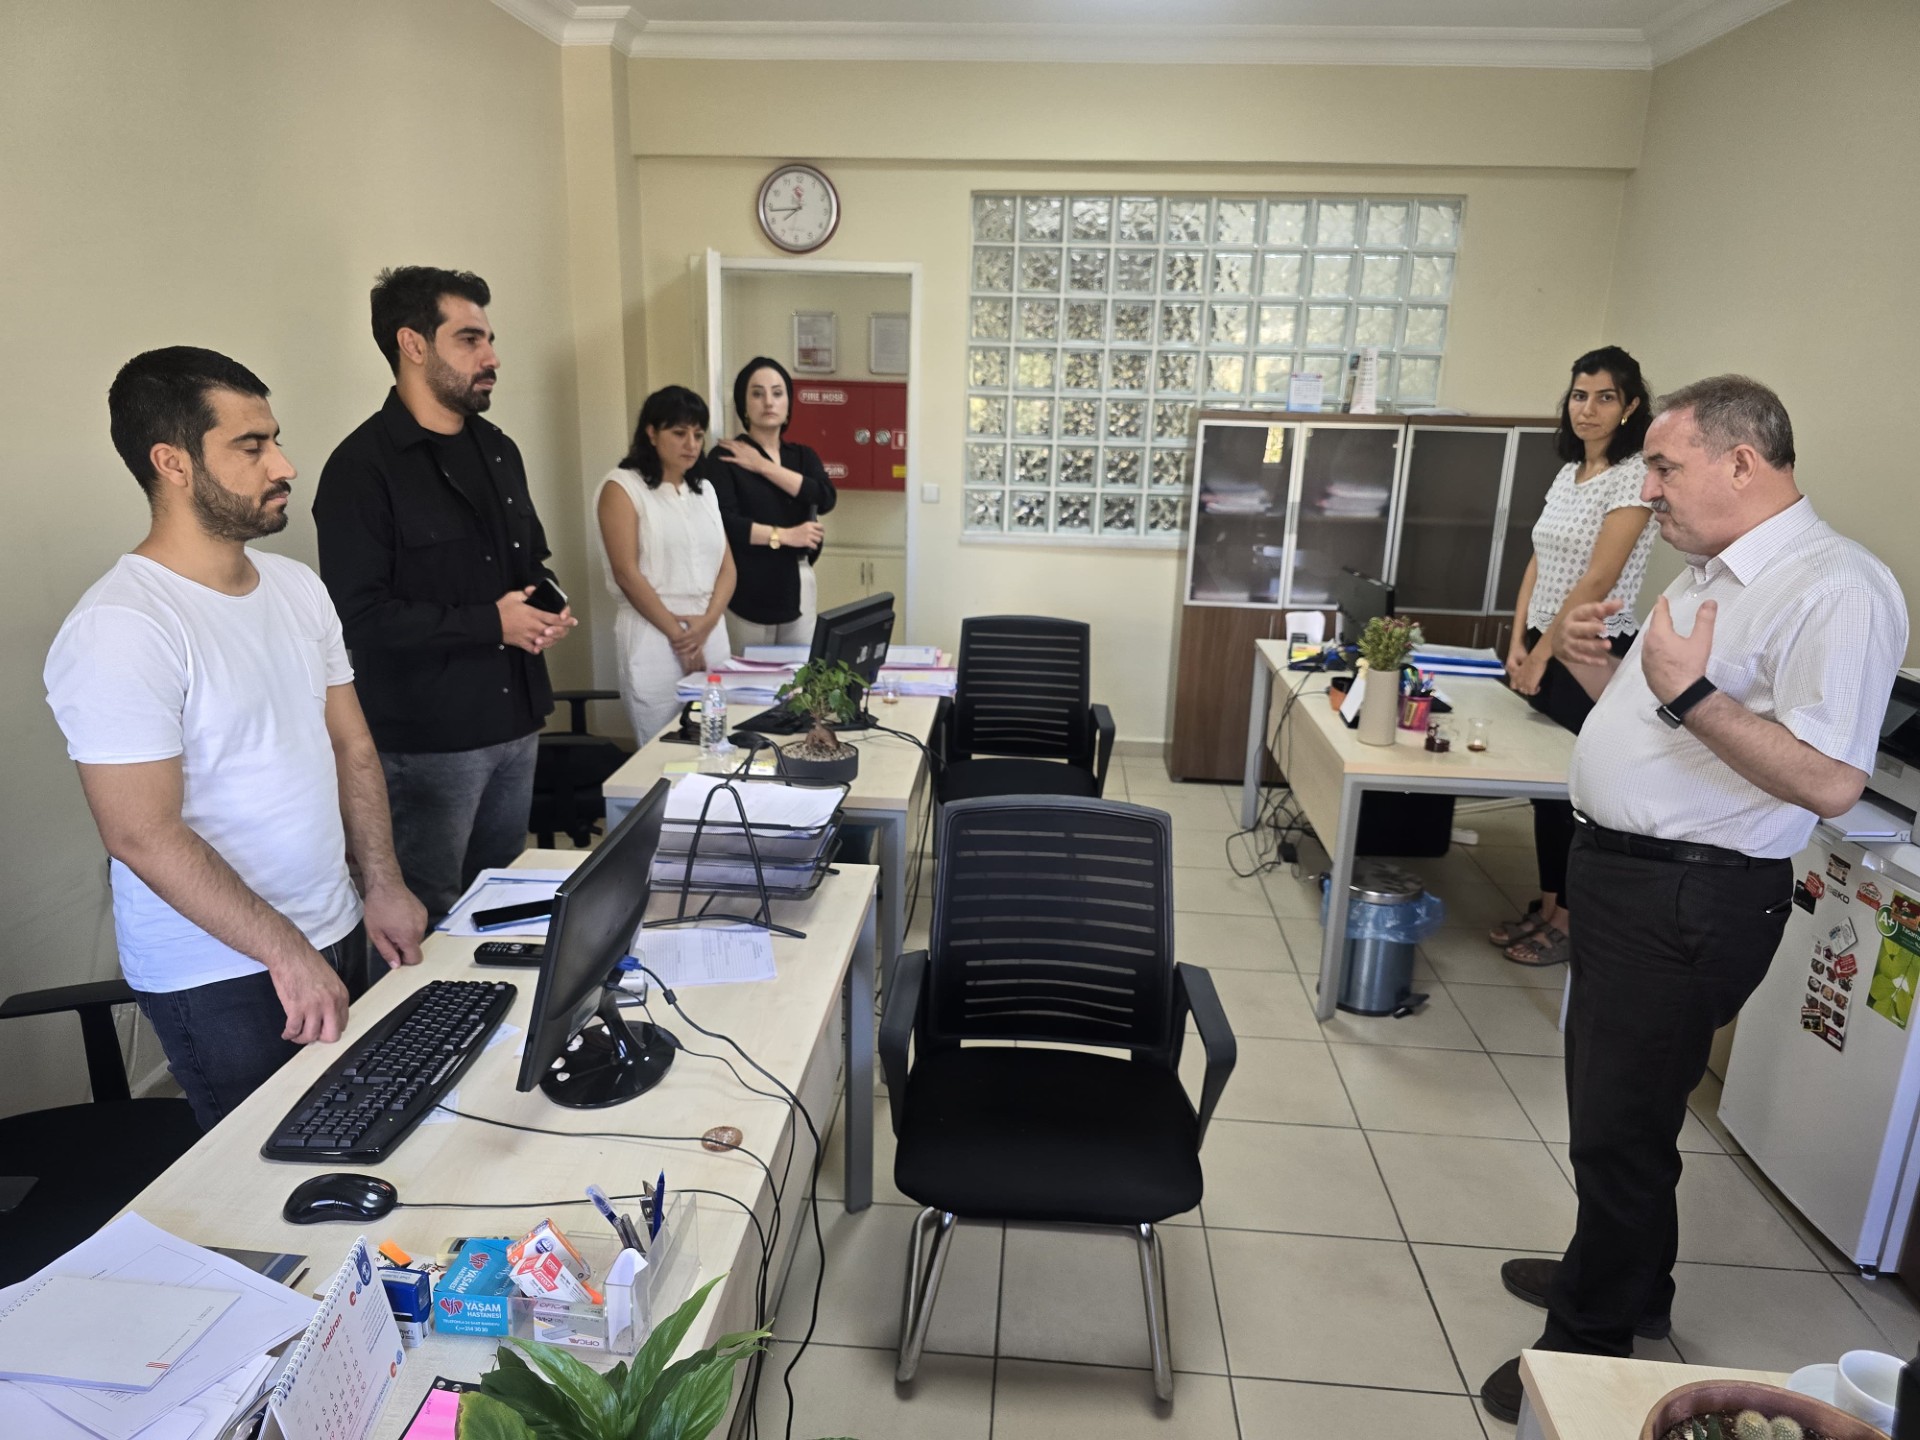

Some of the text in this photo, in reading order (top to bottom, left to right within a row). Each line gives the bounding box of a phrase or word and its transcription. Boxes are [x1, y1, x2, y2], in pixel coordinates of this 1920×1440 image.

[801, 391, 844, 403] FIRE HOSE
[1878, 911, 1895, 927] A+
[464, 1301, 501, 1313] YAŞAM
[467, 1311, 502, 1319] HASTANESİ
[321, 1313, 342, 1352] haziran
[332, 1402, 339, 1417] 13
[352, 1359, 359, 1371] 16
